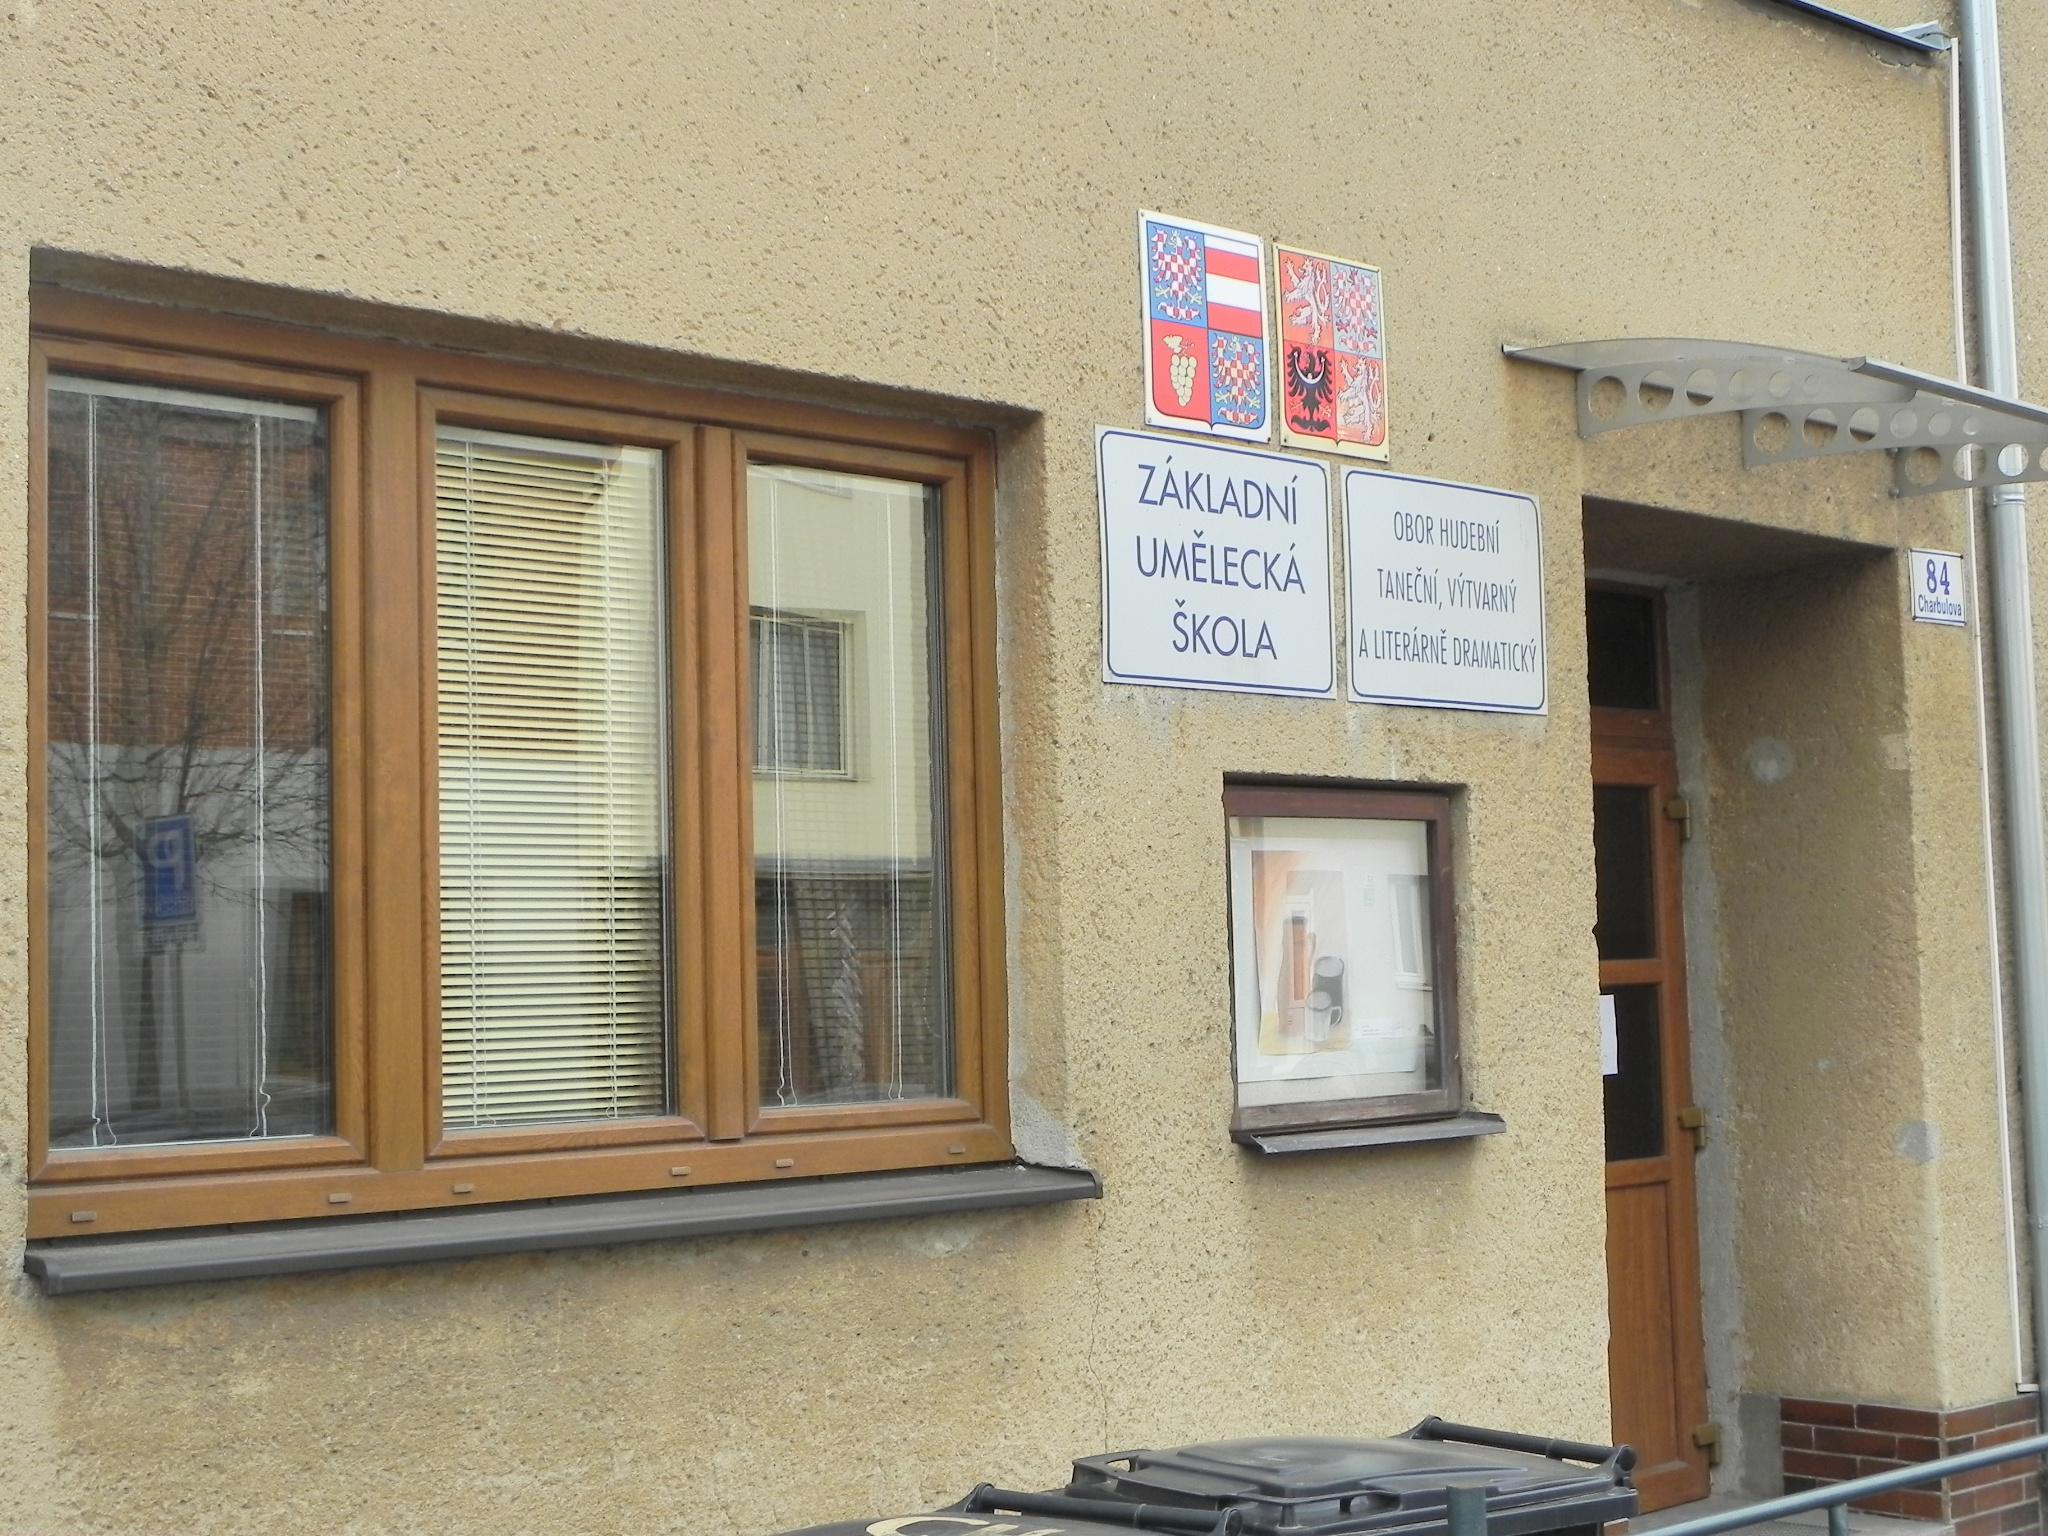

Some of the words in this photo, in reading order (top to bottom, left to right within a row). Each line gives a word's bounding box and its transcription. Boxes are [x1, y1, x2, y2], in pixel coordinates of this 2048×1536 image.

[1138, 455, 1298, 525] ZÁKLADNÍ
[1393, 511, 1434, 544] OBOR
[1439, 517, 1500, 555] HUDEBNÍ
[1136, 530, 1306, 594] UMĚLECKÁ
[1926, 559, 1950, 595] 84
[1377, 566, 1442, 611] TANEČNÍ,
[1448, 572, 1517, 614] VÝTVARNÝ
[1918, 594, 1962, 616] Charbulova
[1172, 599, 1277, 660] ŠKOLA
[1359, 628, 1369, 659] A
[1374, 626, 1448, 665] LITERÁRNĚ
[1453, 637, 1537, 673] DRAMATICKÝ
